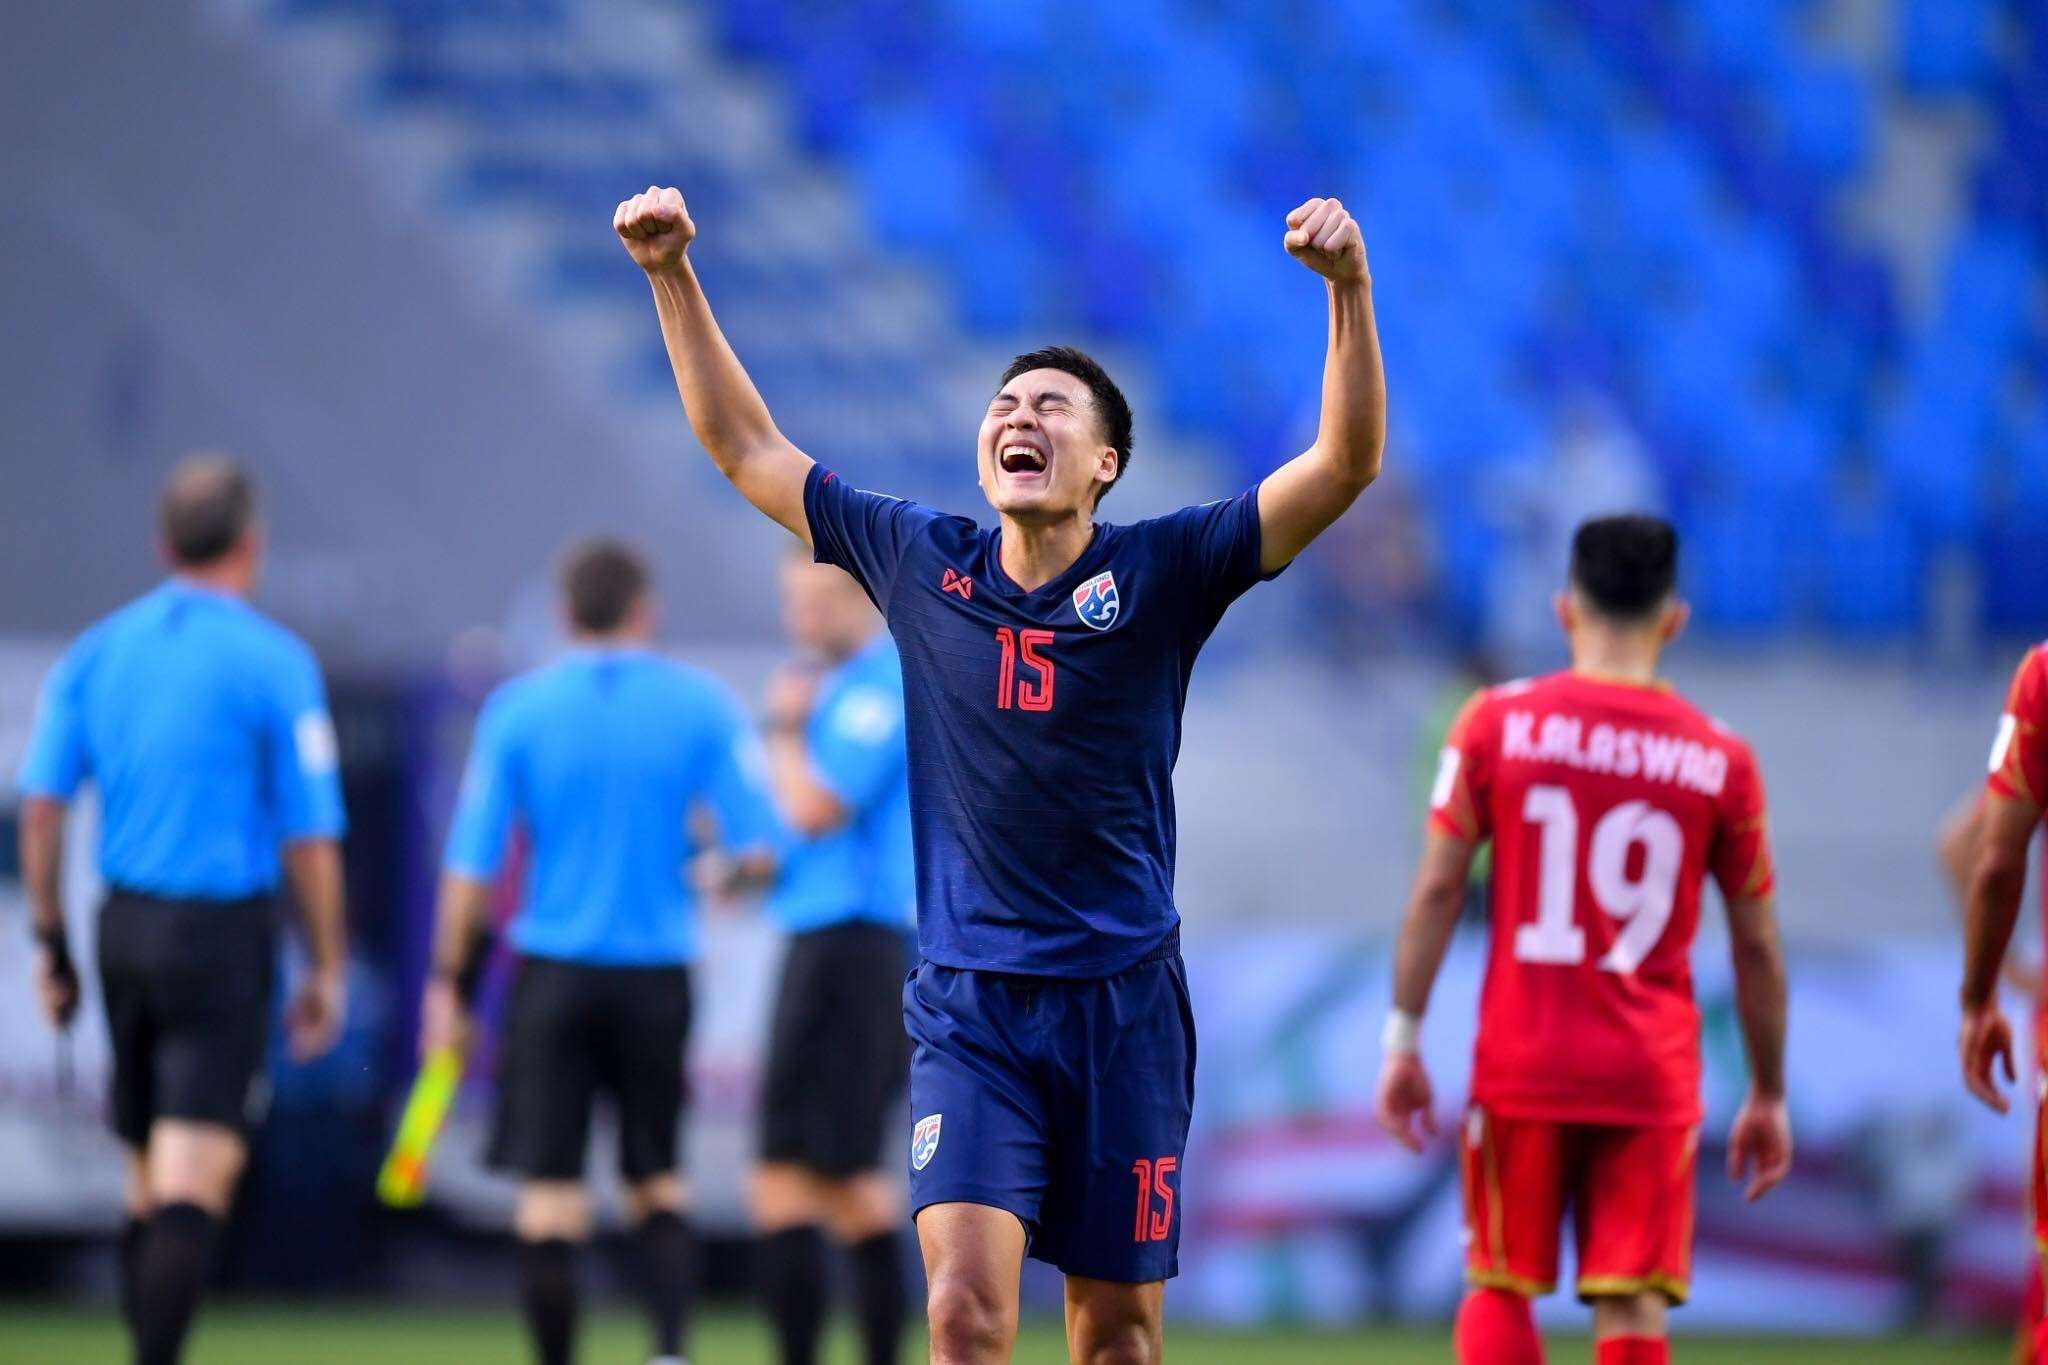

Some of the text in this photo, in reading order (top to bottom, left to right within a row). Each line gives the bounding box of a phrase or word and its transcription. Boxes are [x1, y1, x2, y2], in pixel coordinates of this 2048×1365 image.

[995, 627, 1055, 711] 15
[1514, 784, 1684, 975] 19
[1132, 1156, 1176, 1242] 15
